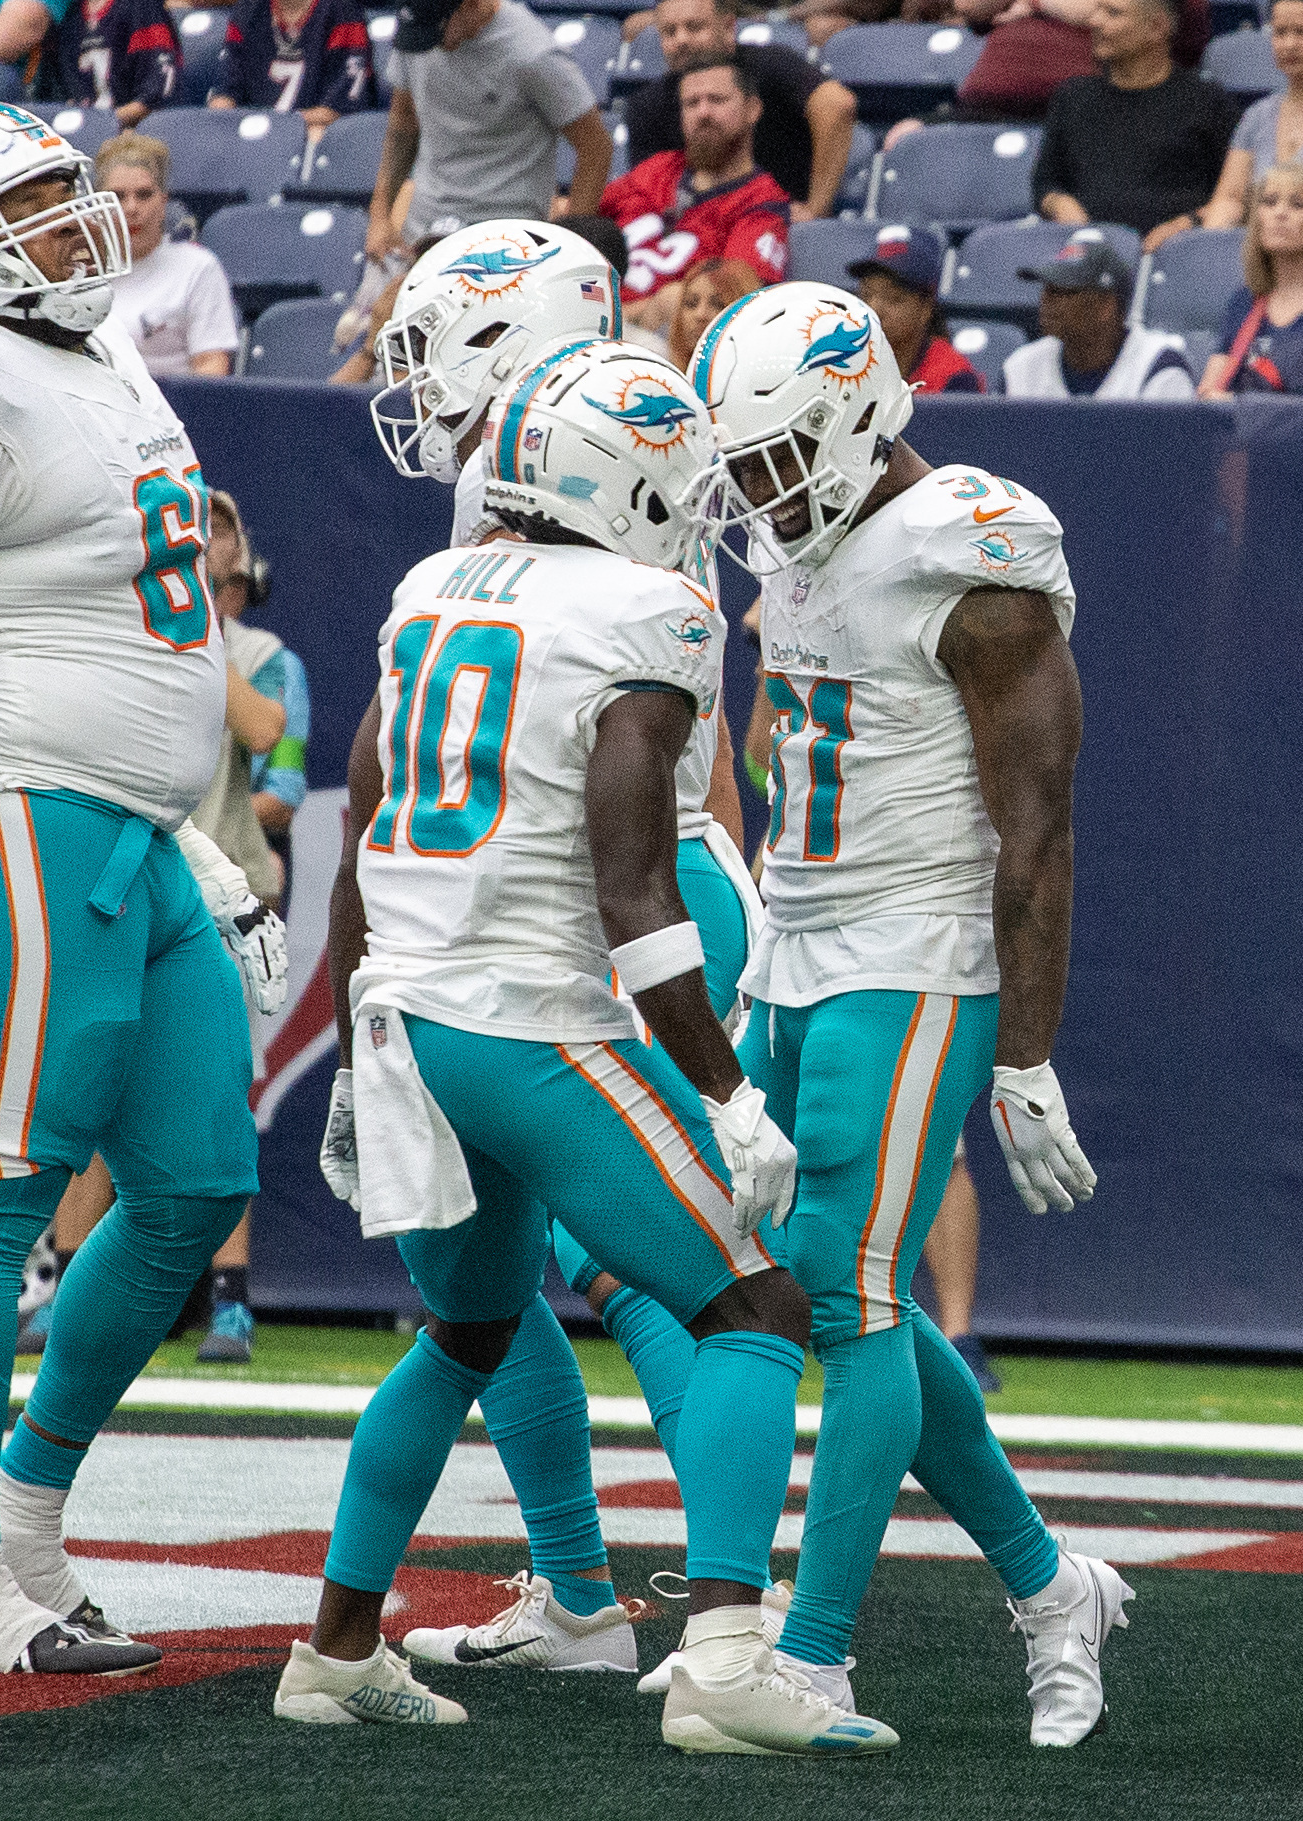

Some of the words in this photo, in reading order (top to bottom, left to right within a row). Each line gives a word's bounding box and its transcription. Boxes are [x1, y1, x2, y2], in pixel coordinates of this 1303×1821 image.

[269, 58, 305, 113] 7
[436, 552, 536, 604] HILL
[367, 614, 525, 858] 10
[344, 1685, 436, 1722] ADIZERO
